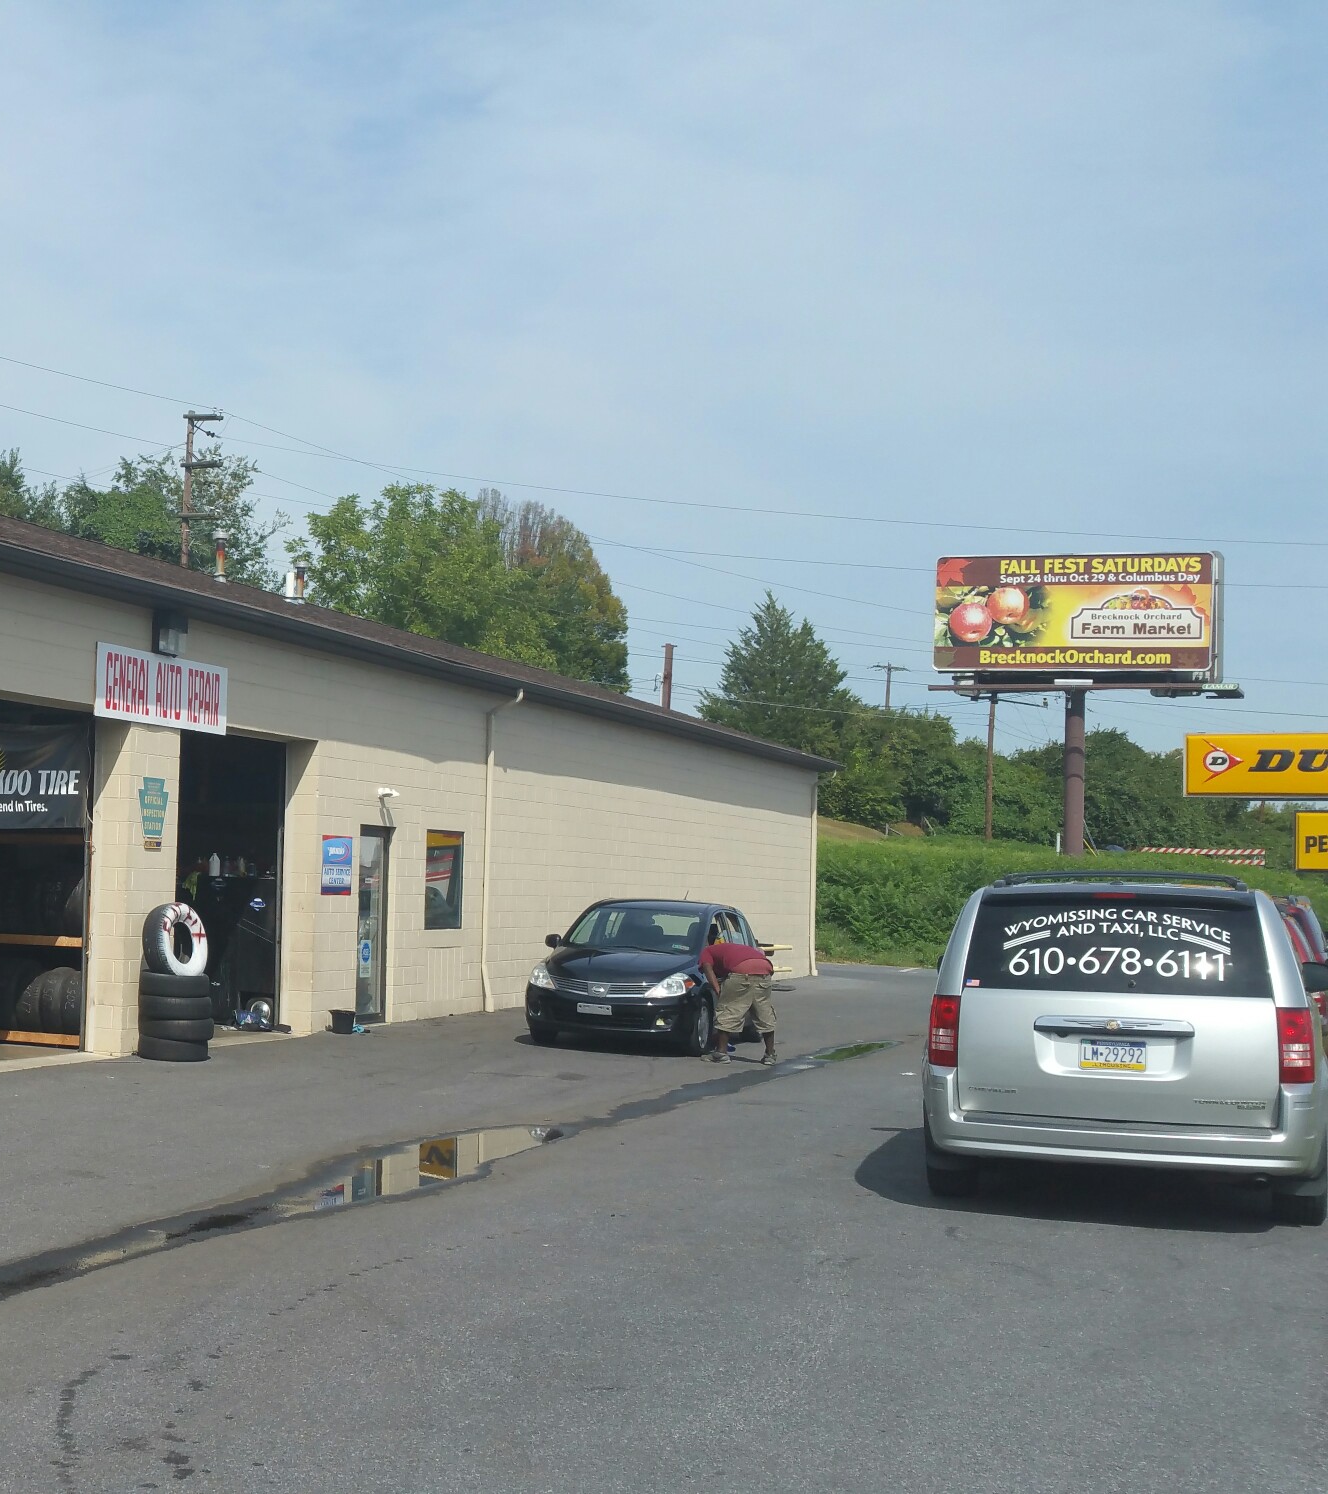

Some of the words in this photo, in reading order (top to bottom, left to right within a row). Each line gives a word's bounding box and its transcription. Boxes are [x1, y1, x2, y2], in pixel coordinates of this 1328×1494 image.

[1000, 559, 1040, 574] FALL
[1044, 558, 1087, 574] FEST
[1091, 557, 1202, 573] SATURDAYS
[1000, 574, 1025, 584] Sept
[1027, 574, 1041, 583] 24
[1043, 574, 1068, 583] thru
[1069, 573, 1089, 582] Oct
[1091, 573, 1105, 583] 29
[1107, 573, 1117, 582] &
[1118, 572, 1175, 582] Columbus
[1178, 572, 1201, 584] Day
[1091, 613, 1140, 621] Brecknock
[1081, 622, 1125, 635] Farm
[1133, 622, 1192, 635] Market
[979, 649, 1171, 665] BrecknockOrchard.com
[105, 651, 149, 716] GENERAL
[155, 661, 182, 721] AUTO
[187, 668, 220, 727] REPAIR
[38, 770, 81, 795] TIRE
[15, 800, 24, 812] In
[24, 800, 48, 813] Tires.
[144, 795, 163, 805] OFFICIAL
[141, 808, 165, 818] INSPECTION
[144, 821, 161, 830] STATION
[324, 867, 334, 876] AUTO
[335, 867, 351, 876] SERVICE
[1004, 908, 1117, 937] WYOMISSING
[1121, 909, 1158, 923] CAR
[1162, 914, 1231, 944] SERVICE
[1056, 922, 1096, 938] AND
[1099, 922, 1144, 938] TAXI,
[1149, 925, 1179, 941] LLC
